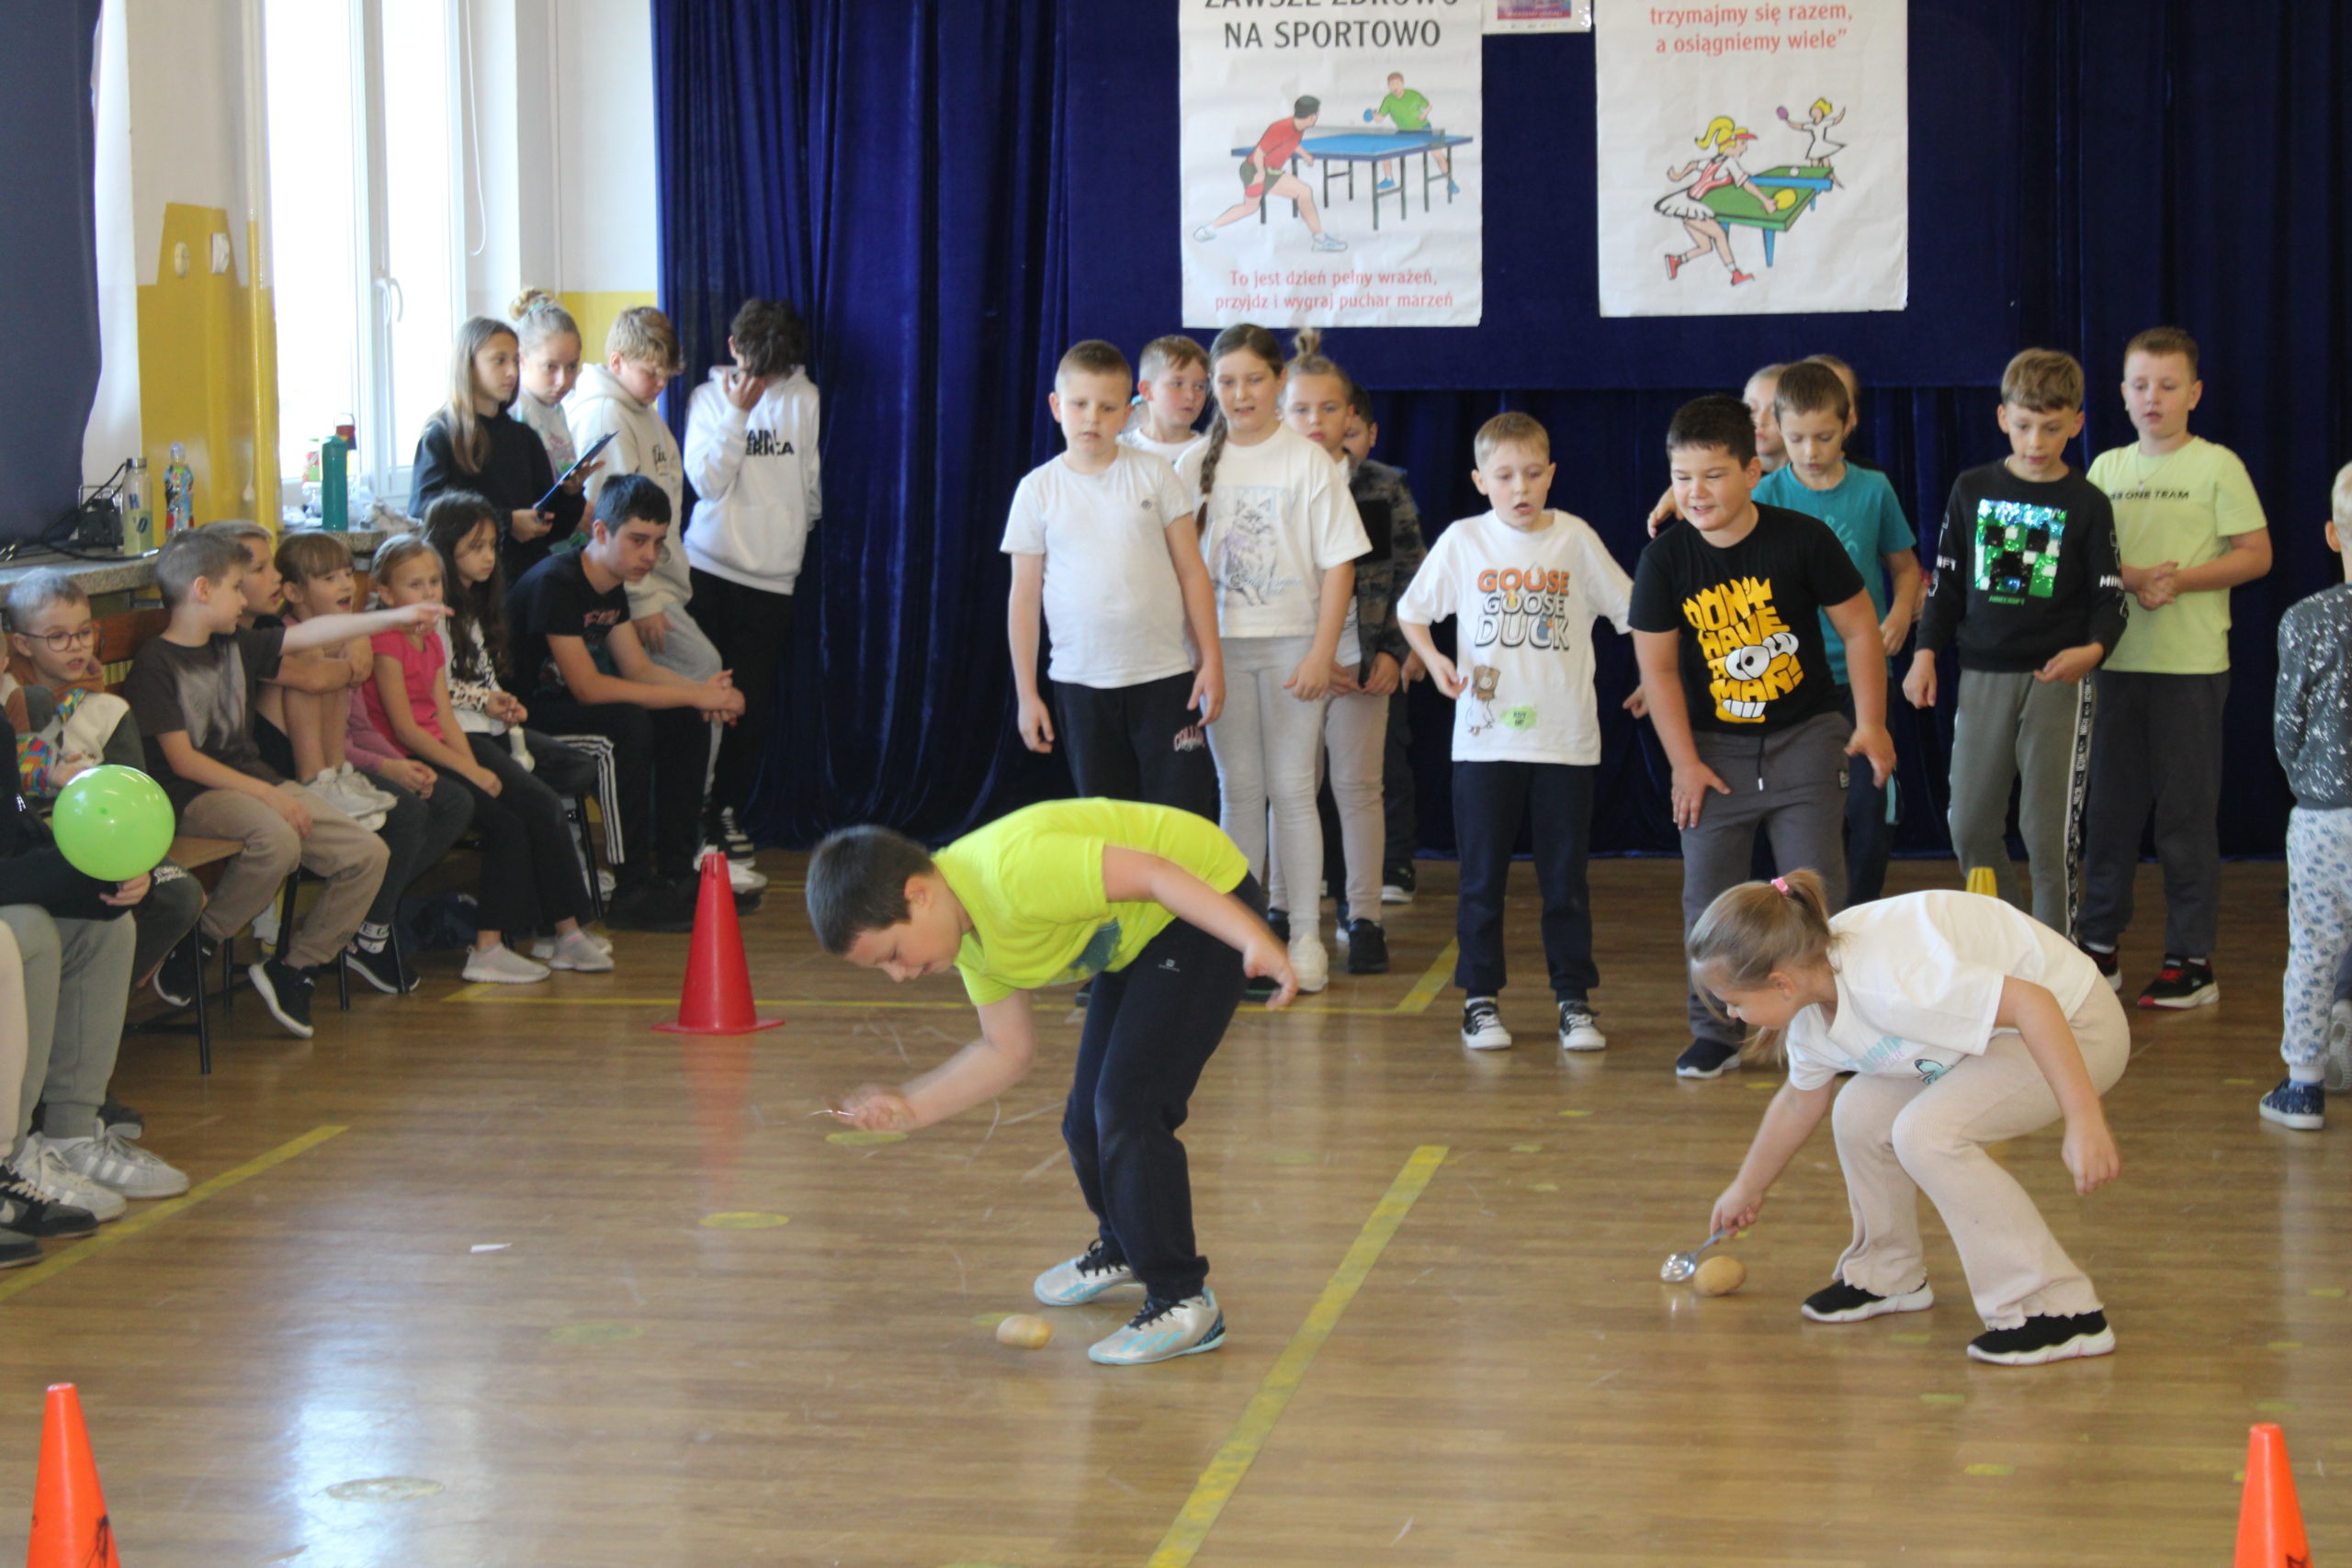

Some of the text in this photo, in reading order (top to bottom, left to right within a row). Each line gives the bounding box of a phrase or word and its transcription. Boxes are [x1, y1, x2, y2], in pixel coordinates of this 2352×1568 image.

[1650, 3, 1852, 28] trzymajmy się razem,
[1225, 19, 1441, 48] NA SPORTOWO
[1657, 39, 1666, 53] a
[1674, 32, 1781, 57] osiągniemy
[1229, 270, 1249, 286] To
[1254, 270, 1280, 288] jest
[1286, 269, 1327, 286] dzień
[1378, 268, 1439, 286] wrażeń,
[1273, 293, 1279, 309] i
[1283, 293, 1333, 311] wygraj
[1340, 292, 1391, 310] puchar
[1396, 290, 1453, 308] marzeń
[2125, 491, 2152, 501] ONE
[2154, 491, 2190, 501] TEAM
[1477, 569, 1571, 596] GOOSE
[1483, 592, 1566, 618] GOOSE
[1682, 576, 1773, 631] DON'T
[1475, 614, 1570, 650] DUCK
[1698, 605, 1791, 660] HAVE
